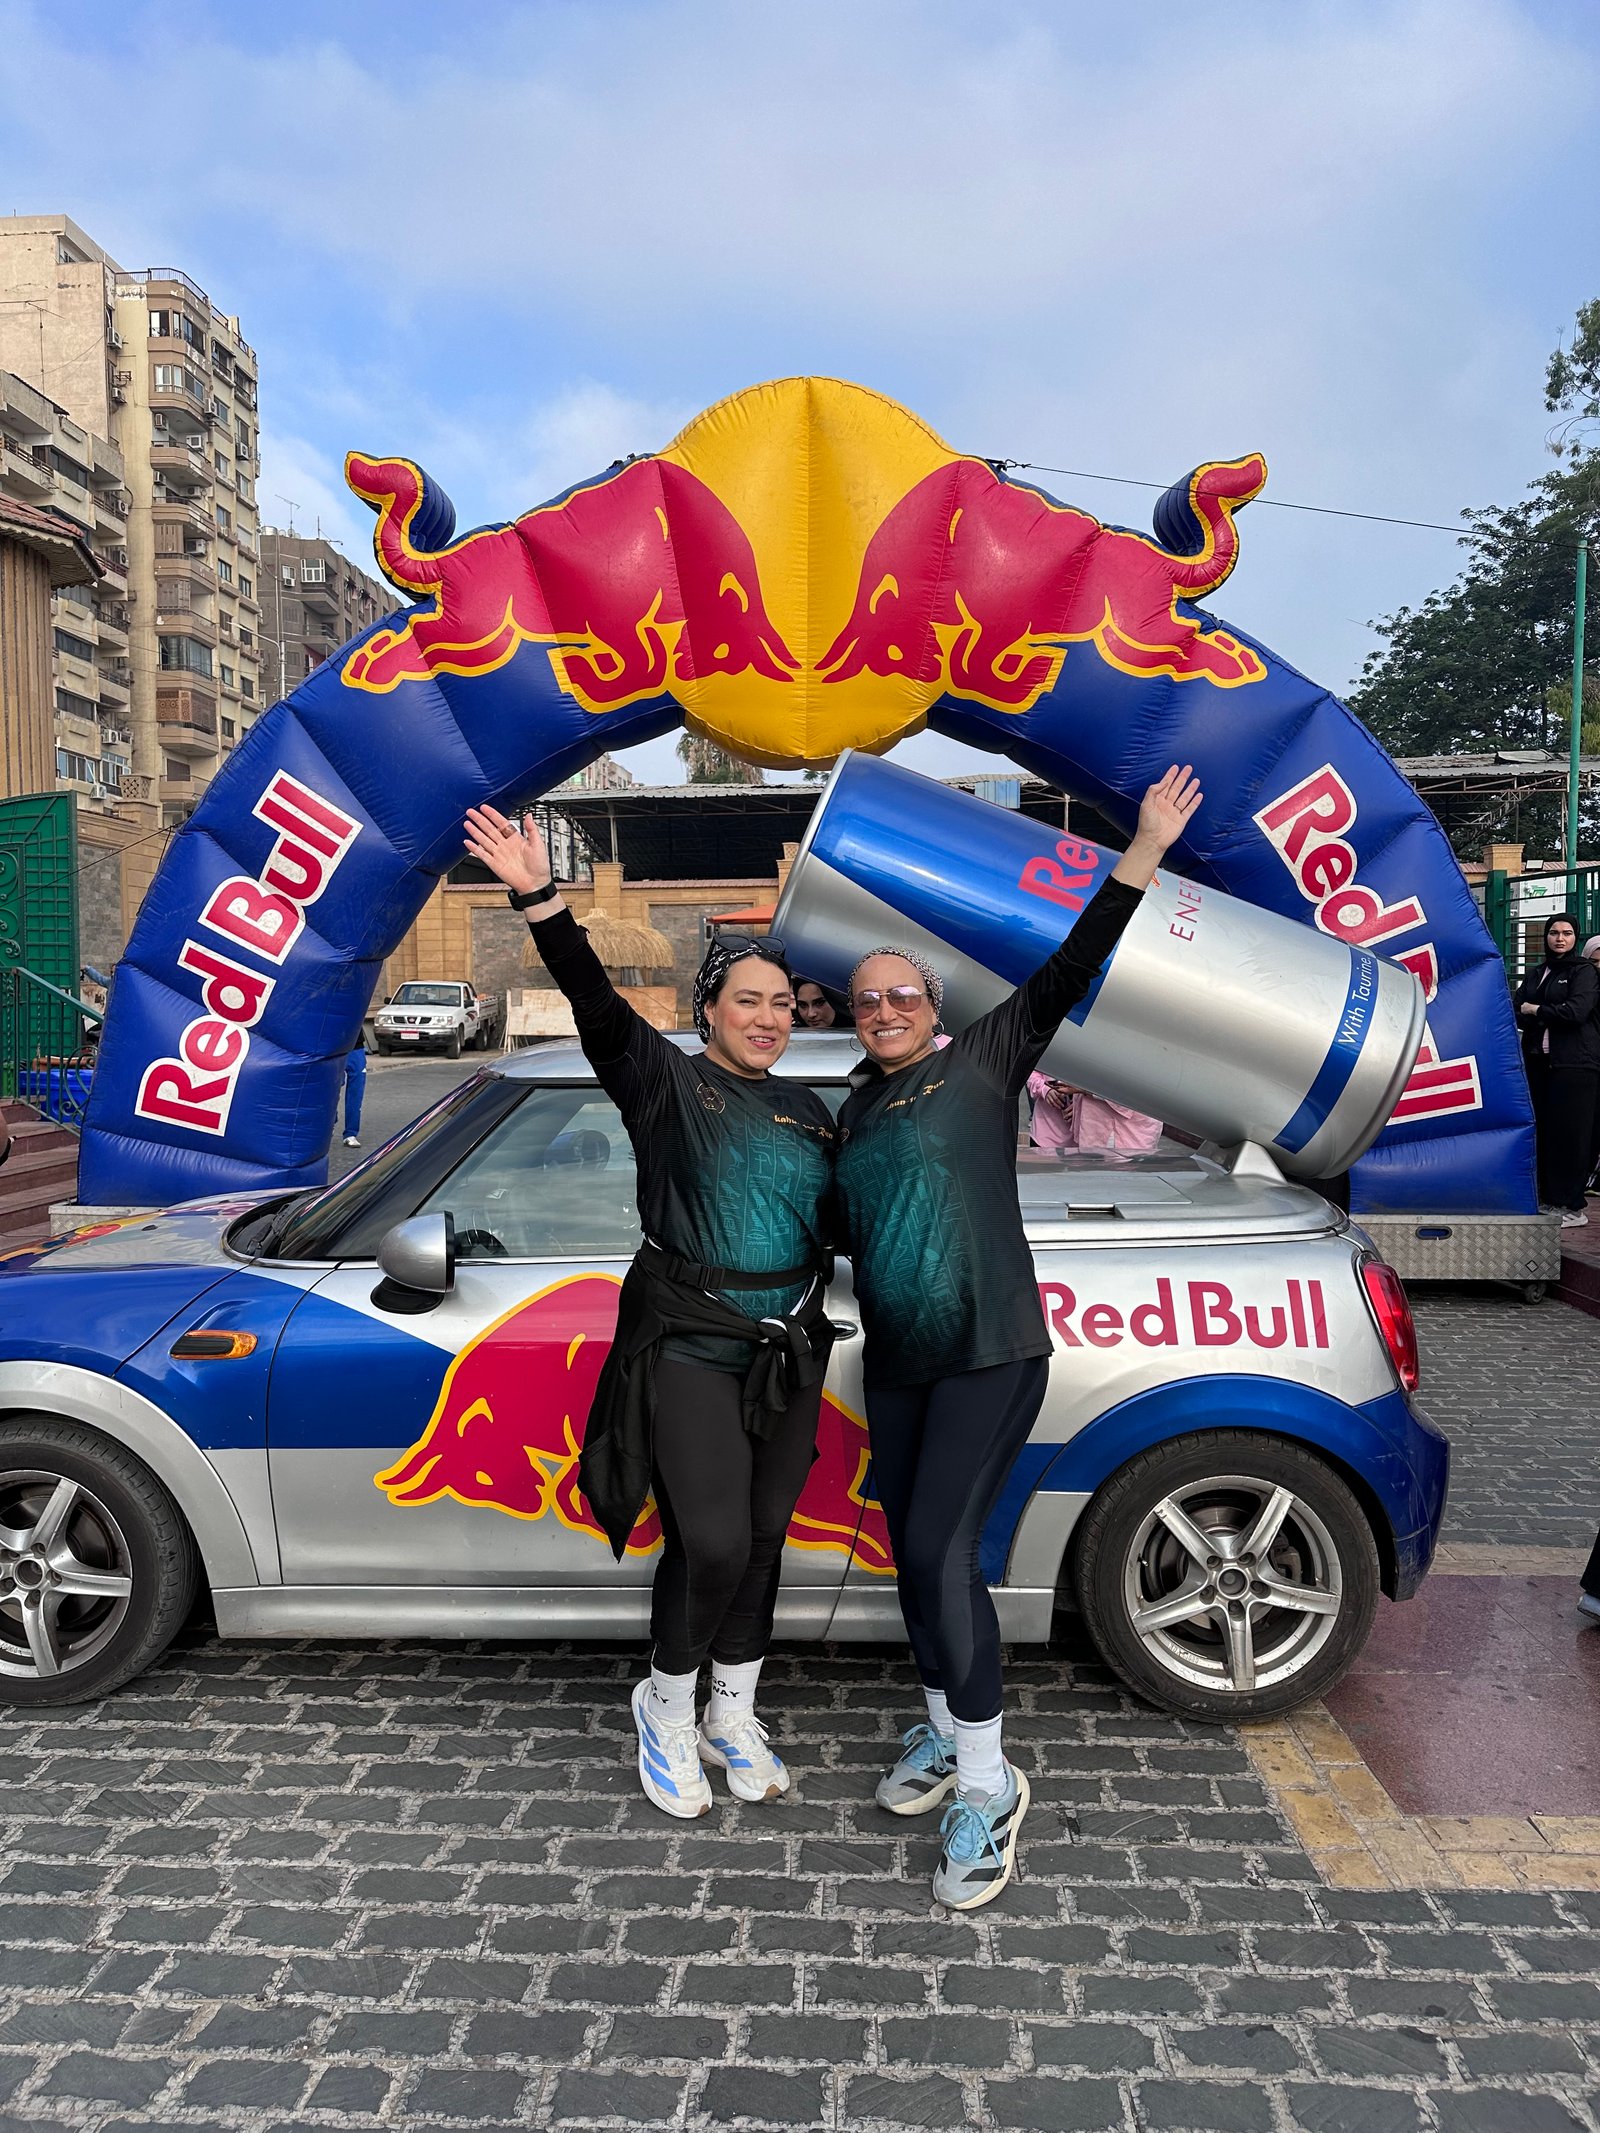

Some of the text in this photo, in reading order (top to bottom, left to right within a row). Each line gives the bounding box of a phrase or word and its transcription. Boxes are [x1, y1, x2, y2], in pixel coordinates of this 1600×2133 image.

[1018, 831, 1100, 912] Re
[1261, 770, 1422, 946] Red
[139, 776, 354, 1131] Red Bull
[1338, 1007, 1366, 1044] With
[922, 1079, 945, 1095] Run
[1037, 1277, 1330, 1349] Red Bull
